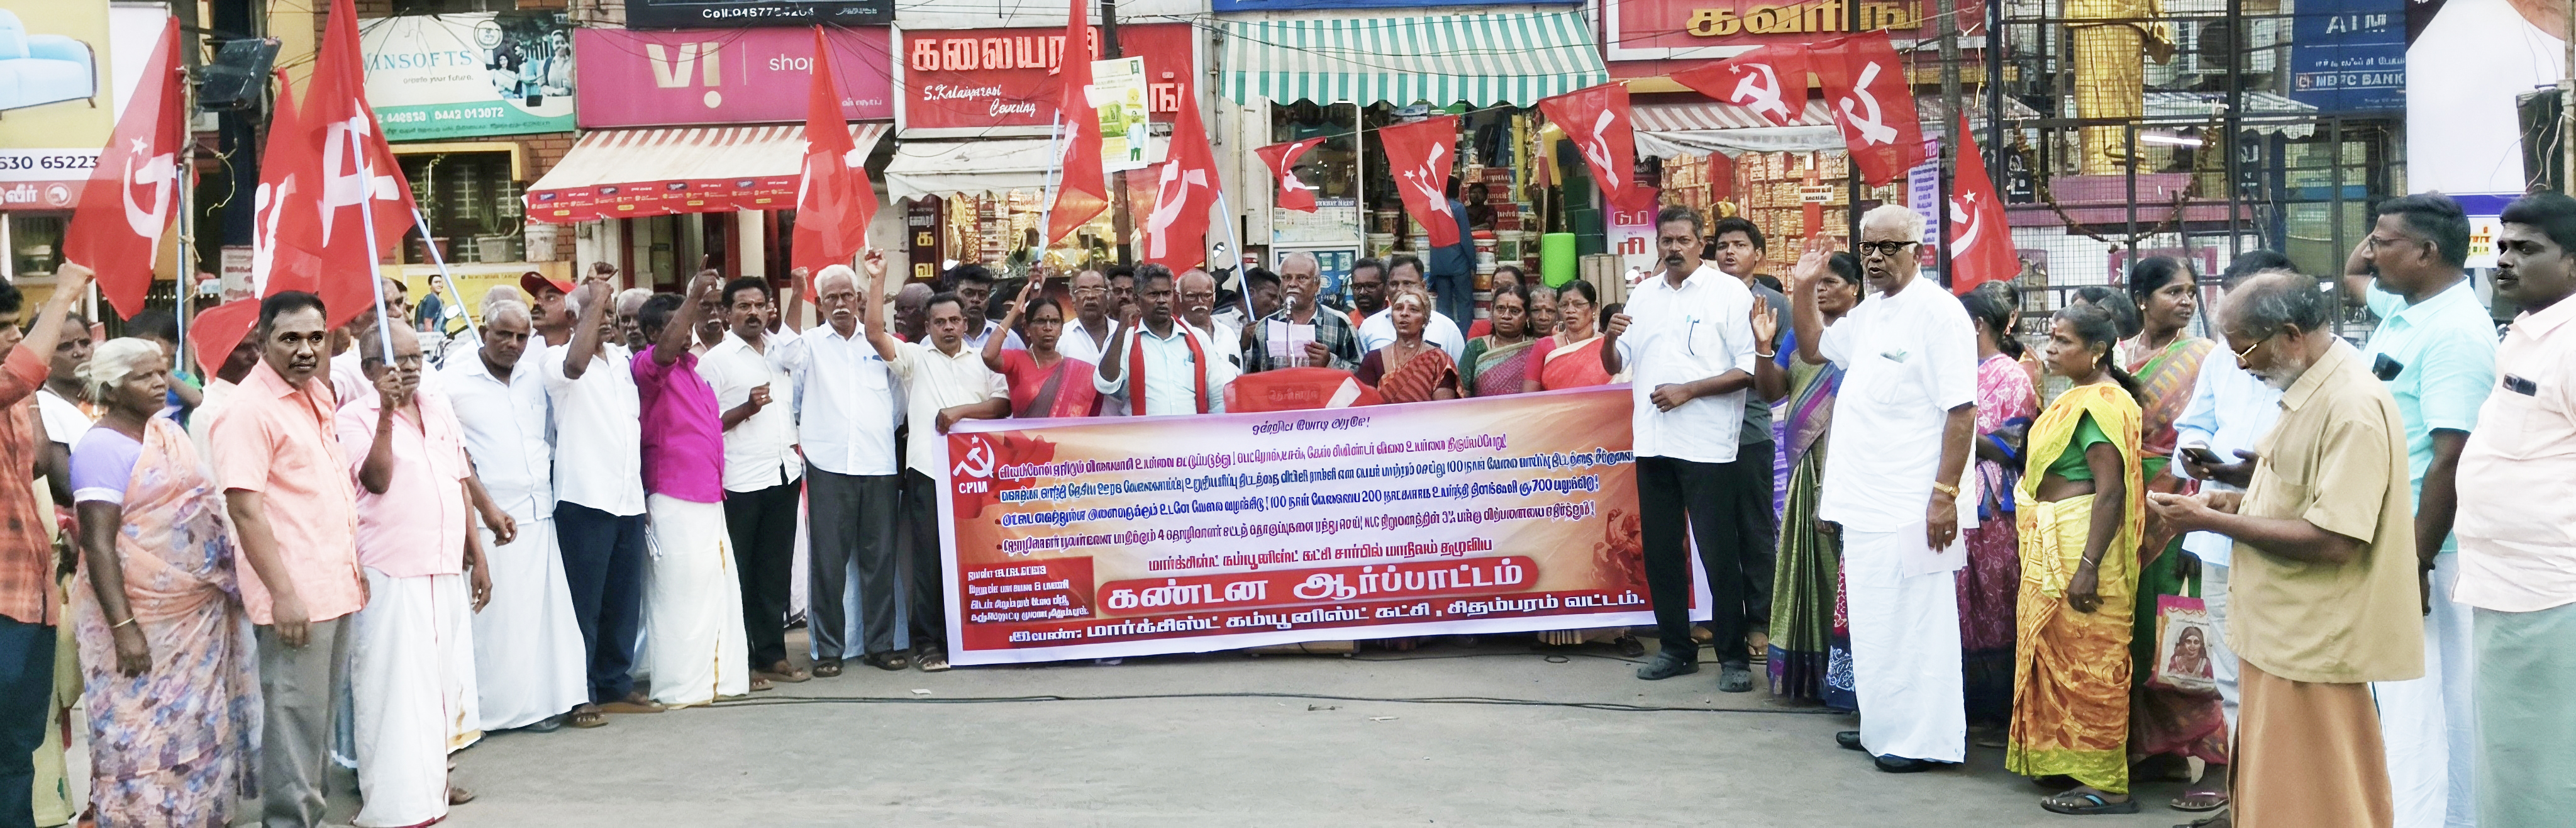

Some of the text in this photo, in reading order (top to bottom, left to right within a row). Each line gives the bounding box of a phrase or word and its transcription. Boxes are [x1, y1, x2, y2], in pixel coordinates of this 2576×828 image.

[1447, 460, 1463, 473] 100
[1270, 495, 1287, 508] 100
[1362, 490, 1382, 502] 200
[1158, 529, 1165, 540] 4
[1108, 557, 1523, 610] கண்டன ஆர்ப்பாட்டம்
[1087, 616, 1221, 637] மார்க்சிஸ்ட்
[1226, 607, 1369, 630] கம்யூனிஸ்ட்
[1375, 601, 1430, 618] கட்சி
[1447, 593, 1558, 617] சிதம்பரம்
